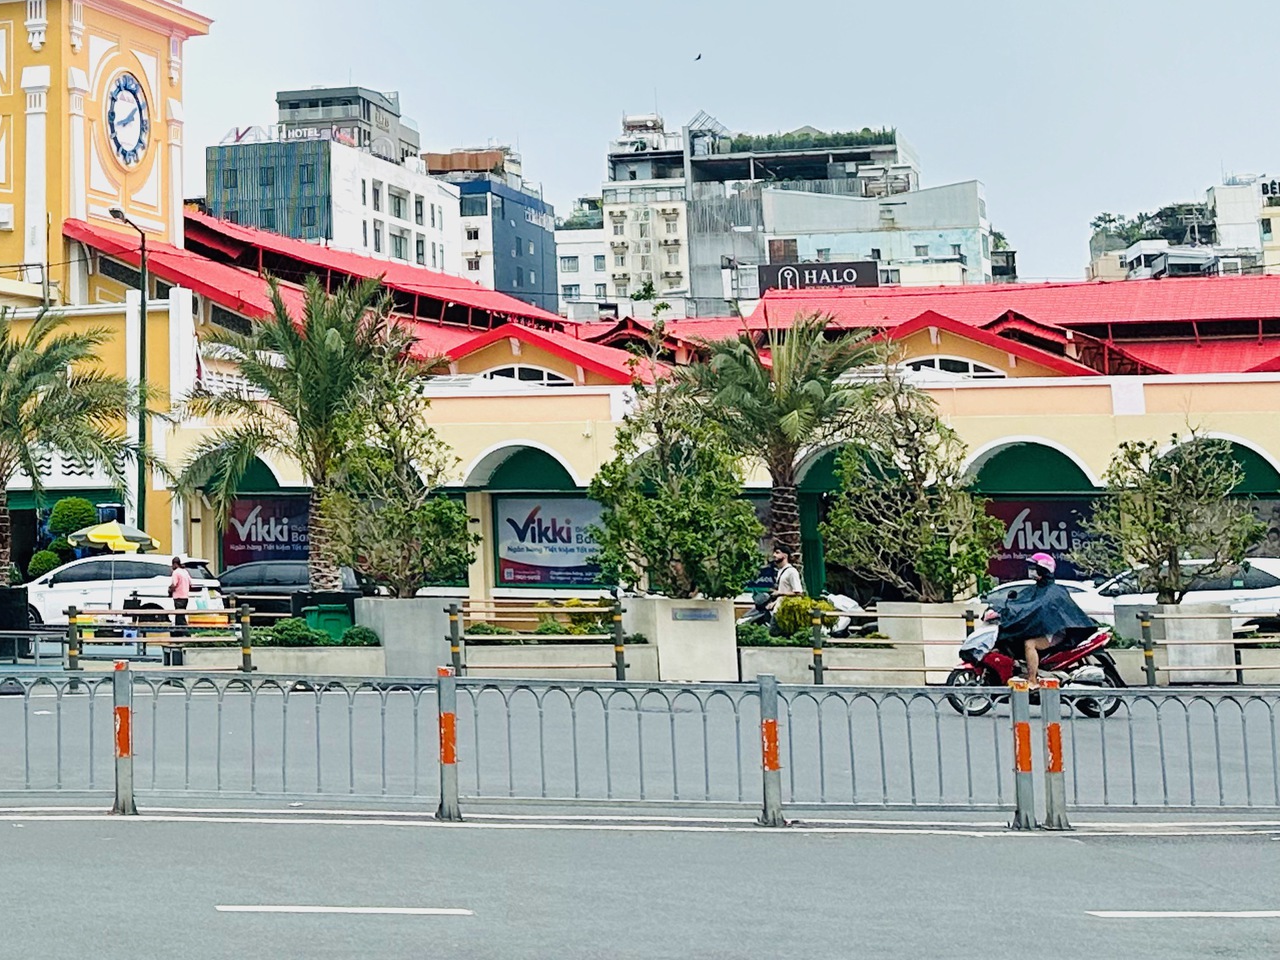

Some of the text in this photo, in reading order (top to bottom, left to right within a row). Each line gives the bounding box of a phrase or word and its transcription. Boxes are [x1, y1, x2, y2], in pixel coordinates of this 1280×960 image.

[288, 128, 321, 139] HOTEL
[804, 268, 857, 284] HALO
[230, 505, 288, 542] Vikki
[506, 505, 572, 543] Vikki
[1002, 508, 1067, 549] Vikki
